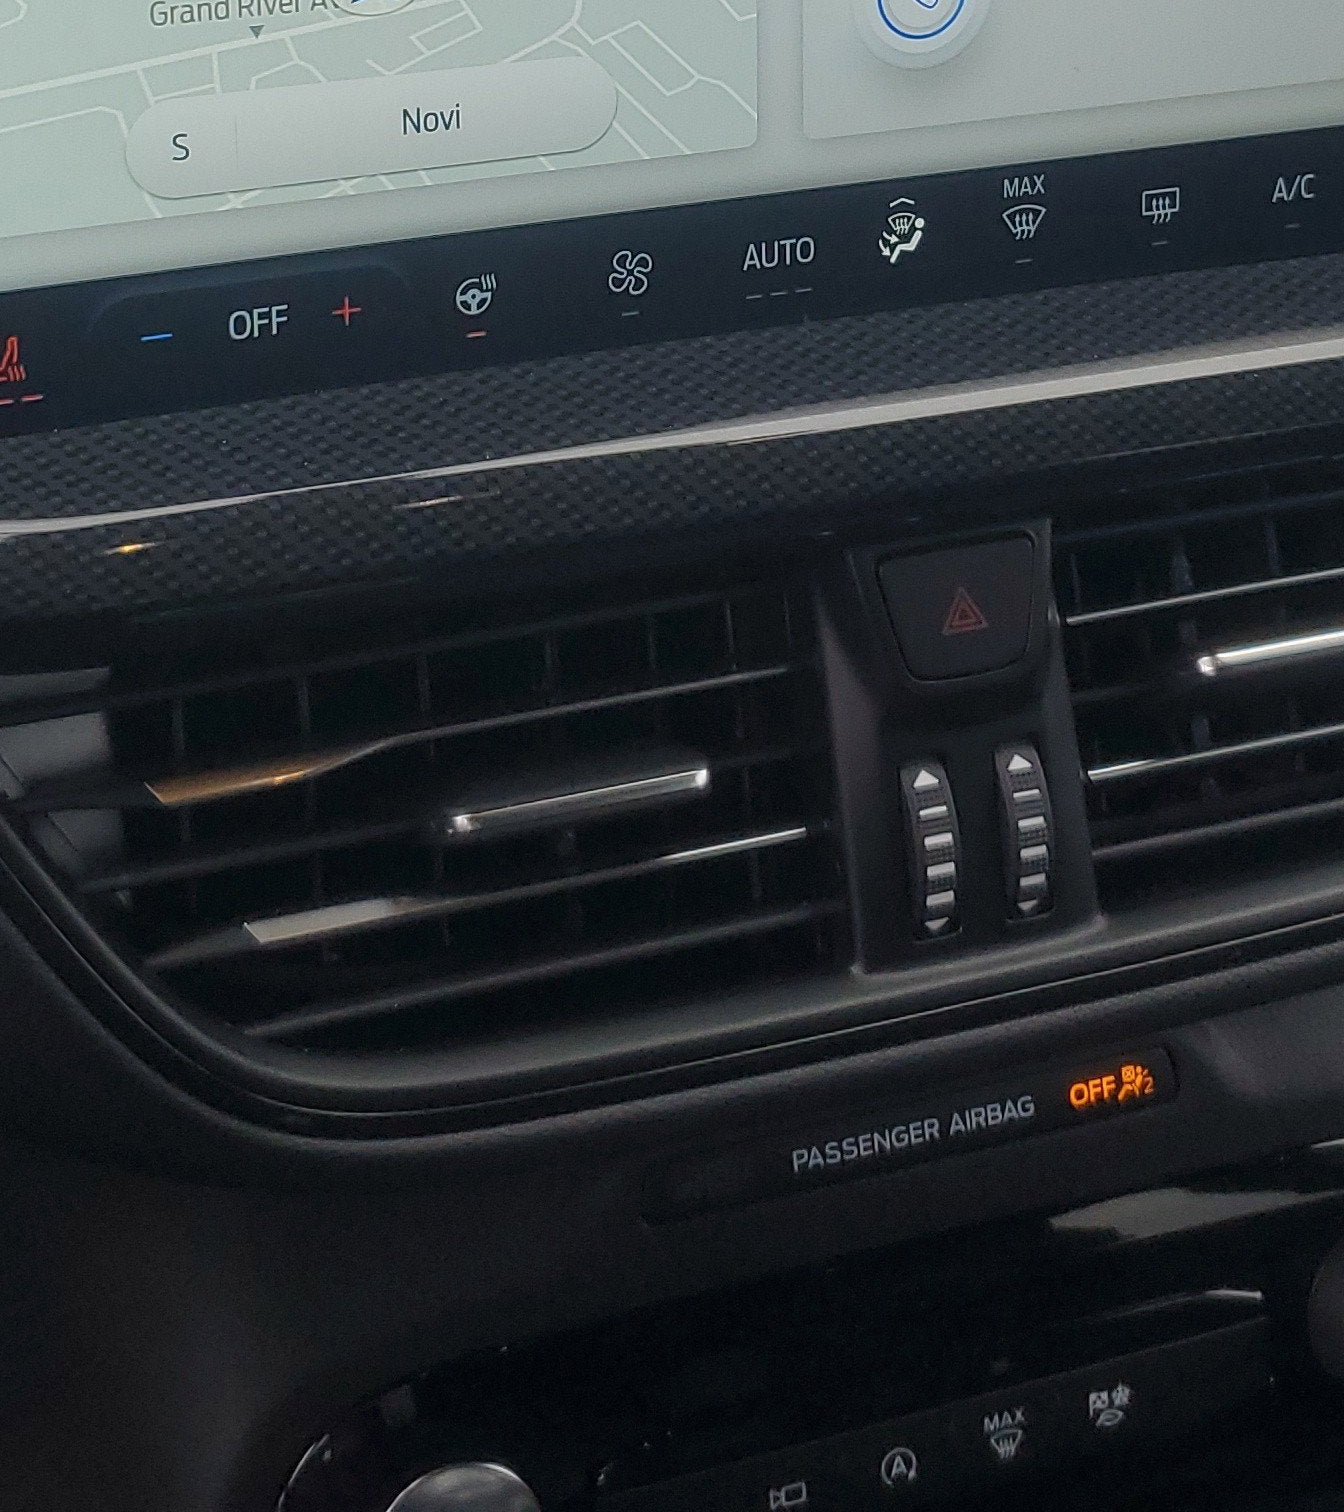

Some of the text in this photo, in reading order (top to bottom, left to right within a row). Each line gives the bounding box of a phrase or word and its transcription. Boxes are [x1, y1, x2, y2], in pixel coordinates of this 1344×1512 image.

[172, 107, 461, 161] S Novi
[1003, 174, 1045, 198] MAX
[1271, 173, 1315, 203] A/C
[743, 236, 815, 271] AUTO
[228, 304, 288, 340] OFF
[792, 1118, 940, 1173] PASSENGER
[949, 1095, 1035, 1136] AIRBAG
[1069, 1074, 1116, 1108] OFF
[983, 1407, 1025, 1433] MAX
